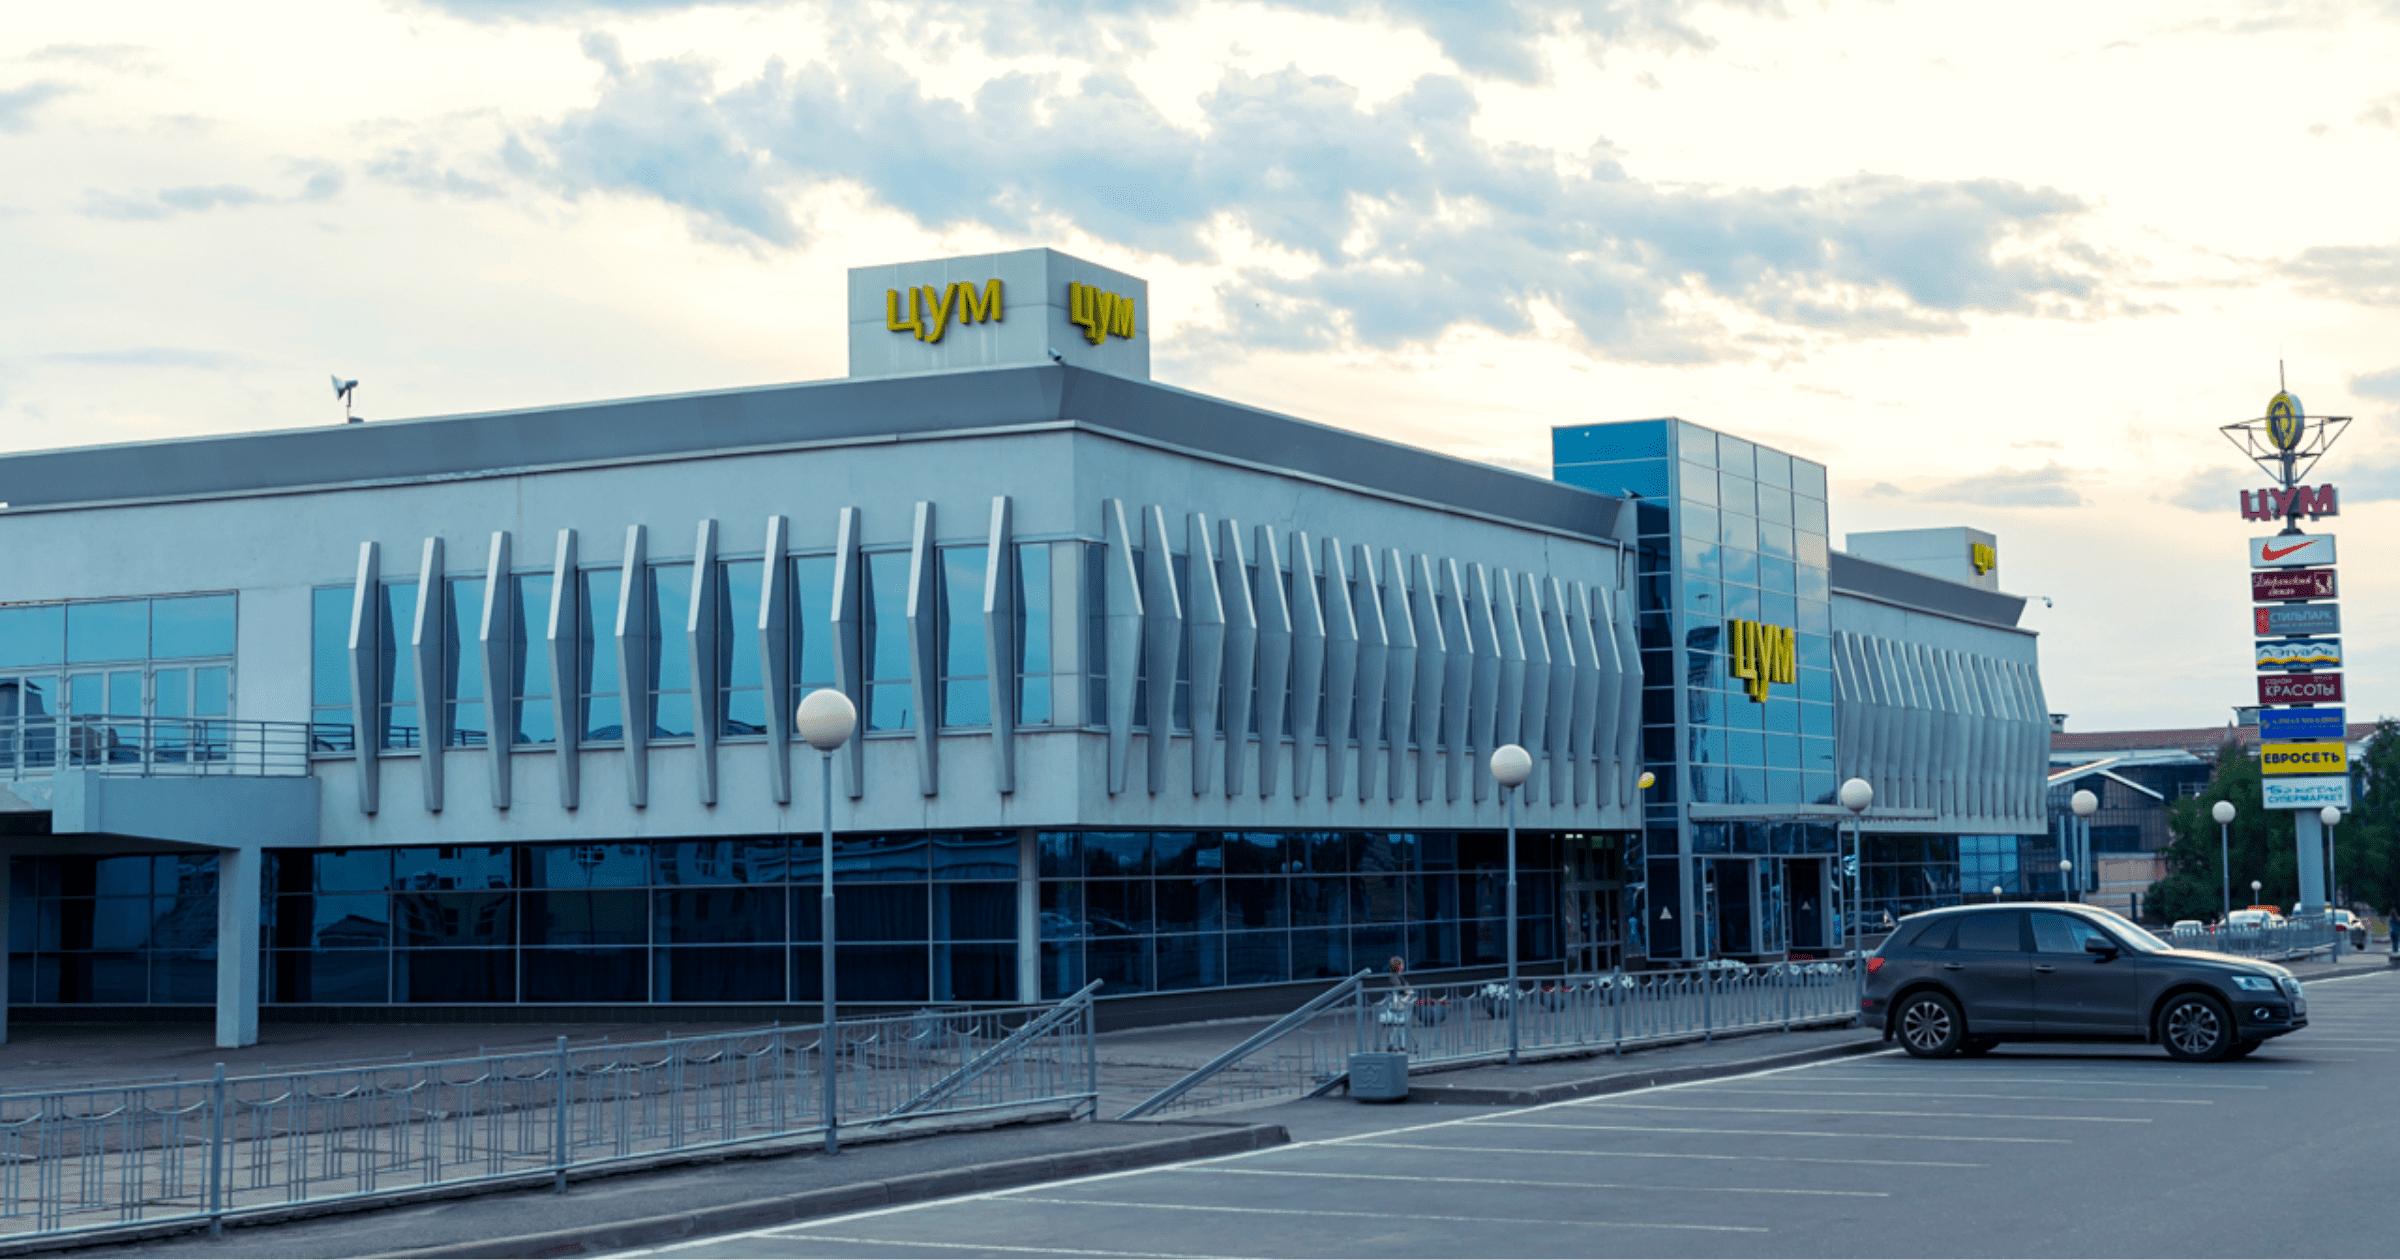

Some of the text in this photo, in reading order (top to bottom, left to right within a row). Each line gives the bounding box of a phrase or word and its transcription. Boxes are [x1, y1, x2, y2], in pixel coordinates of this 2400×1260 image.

[887, 279, 1002, 343] ЦУМ
[1070, 281, 1135, 344] ЦУМ
[2241, 484, 2336, 521] ЦУМ
[1728, 619, 1795, 703] ЦУМ
[2265, 683, 2336, 697] КРАСОТЫ
[2264, 752, 2341, 764] ЕВРОСЕТЬ
[2267, 793, 2343, 804] СУПЕРМАРКЕТ
